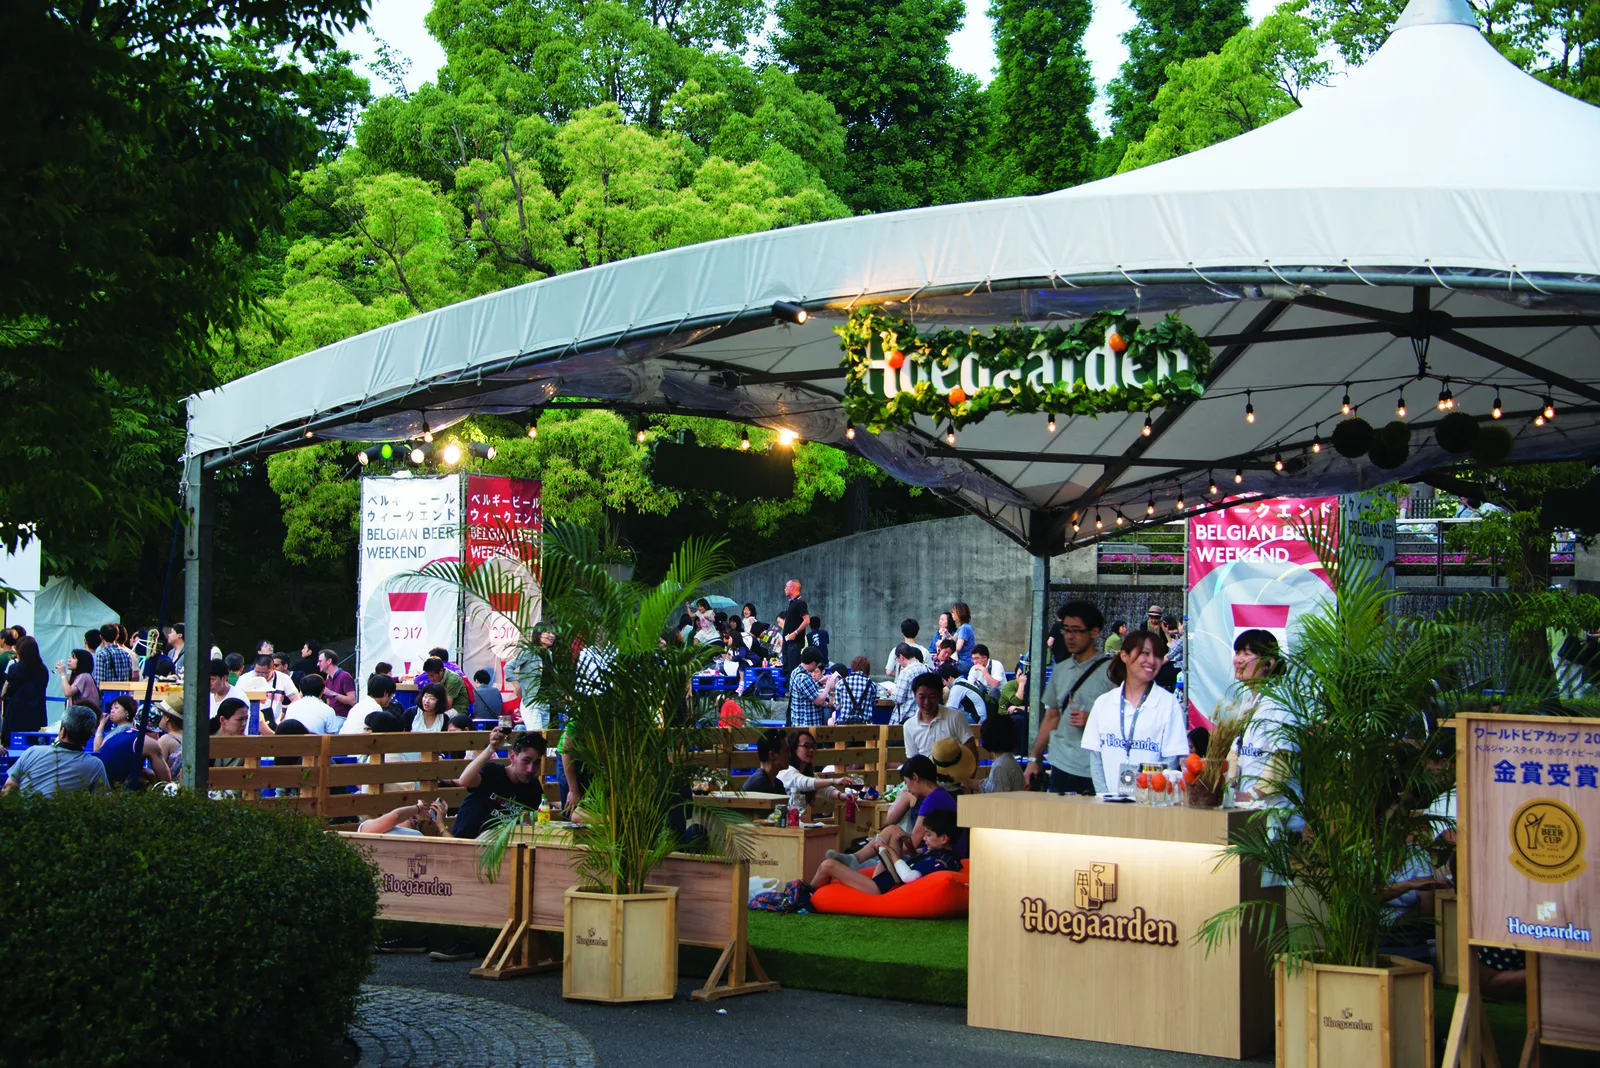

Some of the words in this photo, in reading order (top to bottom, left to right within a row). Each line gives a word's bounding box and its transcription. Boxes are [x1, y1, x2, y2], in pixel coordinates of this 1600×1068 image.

[368, 493, 455, 506] ベルギール
[471, 494, 540, 509] ベルギービール
[367, 508, 455, 522] ウィークエンド
[470, 508, 540, 525] ウィークエンド
[367, 528, 418, 541] BELGIAN
[422, 527, 455, 540] BEER
[1196, 524, 1277, 541] BELGIAN
[1282, 525, 1332, 541] BEER
[1349, 520, 1381, 538] BELGIAN
[367, 546, 427, 559] WEEKEND
[471, 545, 521, 559] WEEKEND
[1196, 547, 1290, 563] WEEKEND
[393, 626, 422, 640] 2017
[1106, 733, 1160, 752] Hoeaarden
[1474, 728, 1580, 743] ワールドビアカップ
[1493, 759, 1599, 788] 金賞受賞
[1541, 828, 1564, 837] BEER
[1543, 835, 1562, 844] CUP
[383, 873, 452, 897] Hoegaarden
[1021, 897, 1179, 947] Hoegaarden
[1507, 916, 1592, 943] Hoegaarden
